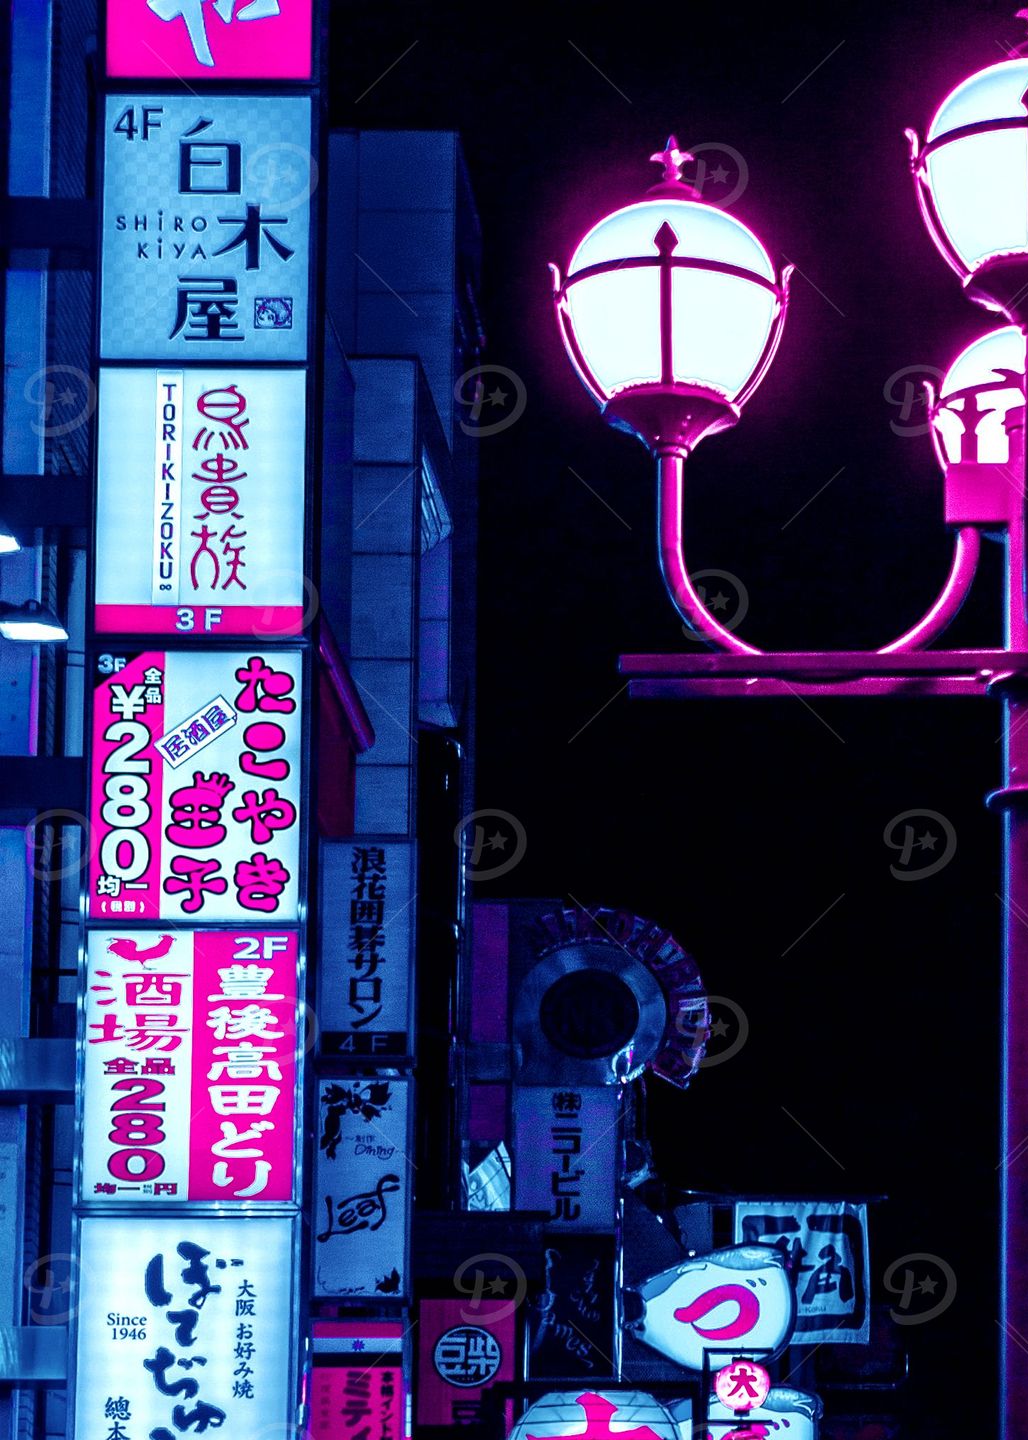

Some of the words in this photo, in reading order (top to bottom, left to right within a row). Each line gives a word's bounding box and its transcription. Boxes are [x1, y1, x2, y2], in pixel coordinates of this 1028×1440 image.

[113, 106, 165, 141] 4F
[168, 118, 296, 343] 白木屋
[160, 383, 177, 581] TORIKIZOKU
[190, 384, 250, 592] 鳥貴族
[175, 607, 222, 631] 3F
[98, 654, 126, 674] 3F
[144, 667, 162, 704] 全品
[160, 704, 232, 763] 居酒屋
[101, 684, 151, 882] ¥280
[232, 655, 297, 914] たこやき
[163, 770, 236, 915] 王子
[232, 936, 290, 960] 2F
[348, 845, 388, 1029] 浪花囲碁サロン
[87, 970, 191, 1052] 酒場
[339, 1034, 389, 1051] 4F
[103, 1056, 176, 1076] 全品
[206, 963, 286, 1198] 豊後高田どり
[107, 1077, 166, 1182] 280
[317, 1173, 400, 1243] Leaf
[107, 1313, 147, 1327] Since
[111, 1328, 147, 1341] 1946
